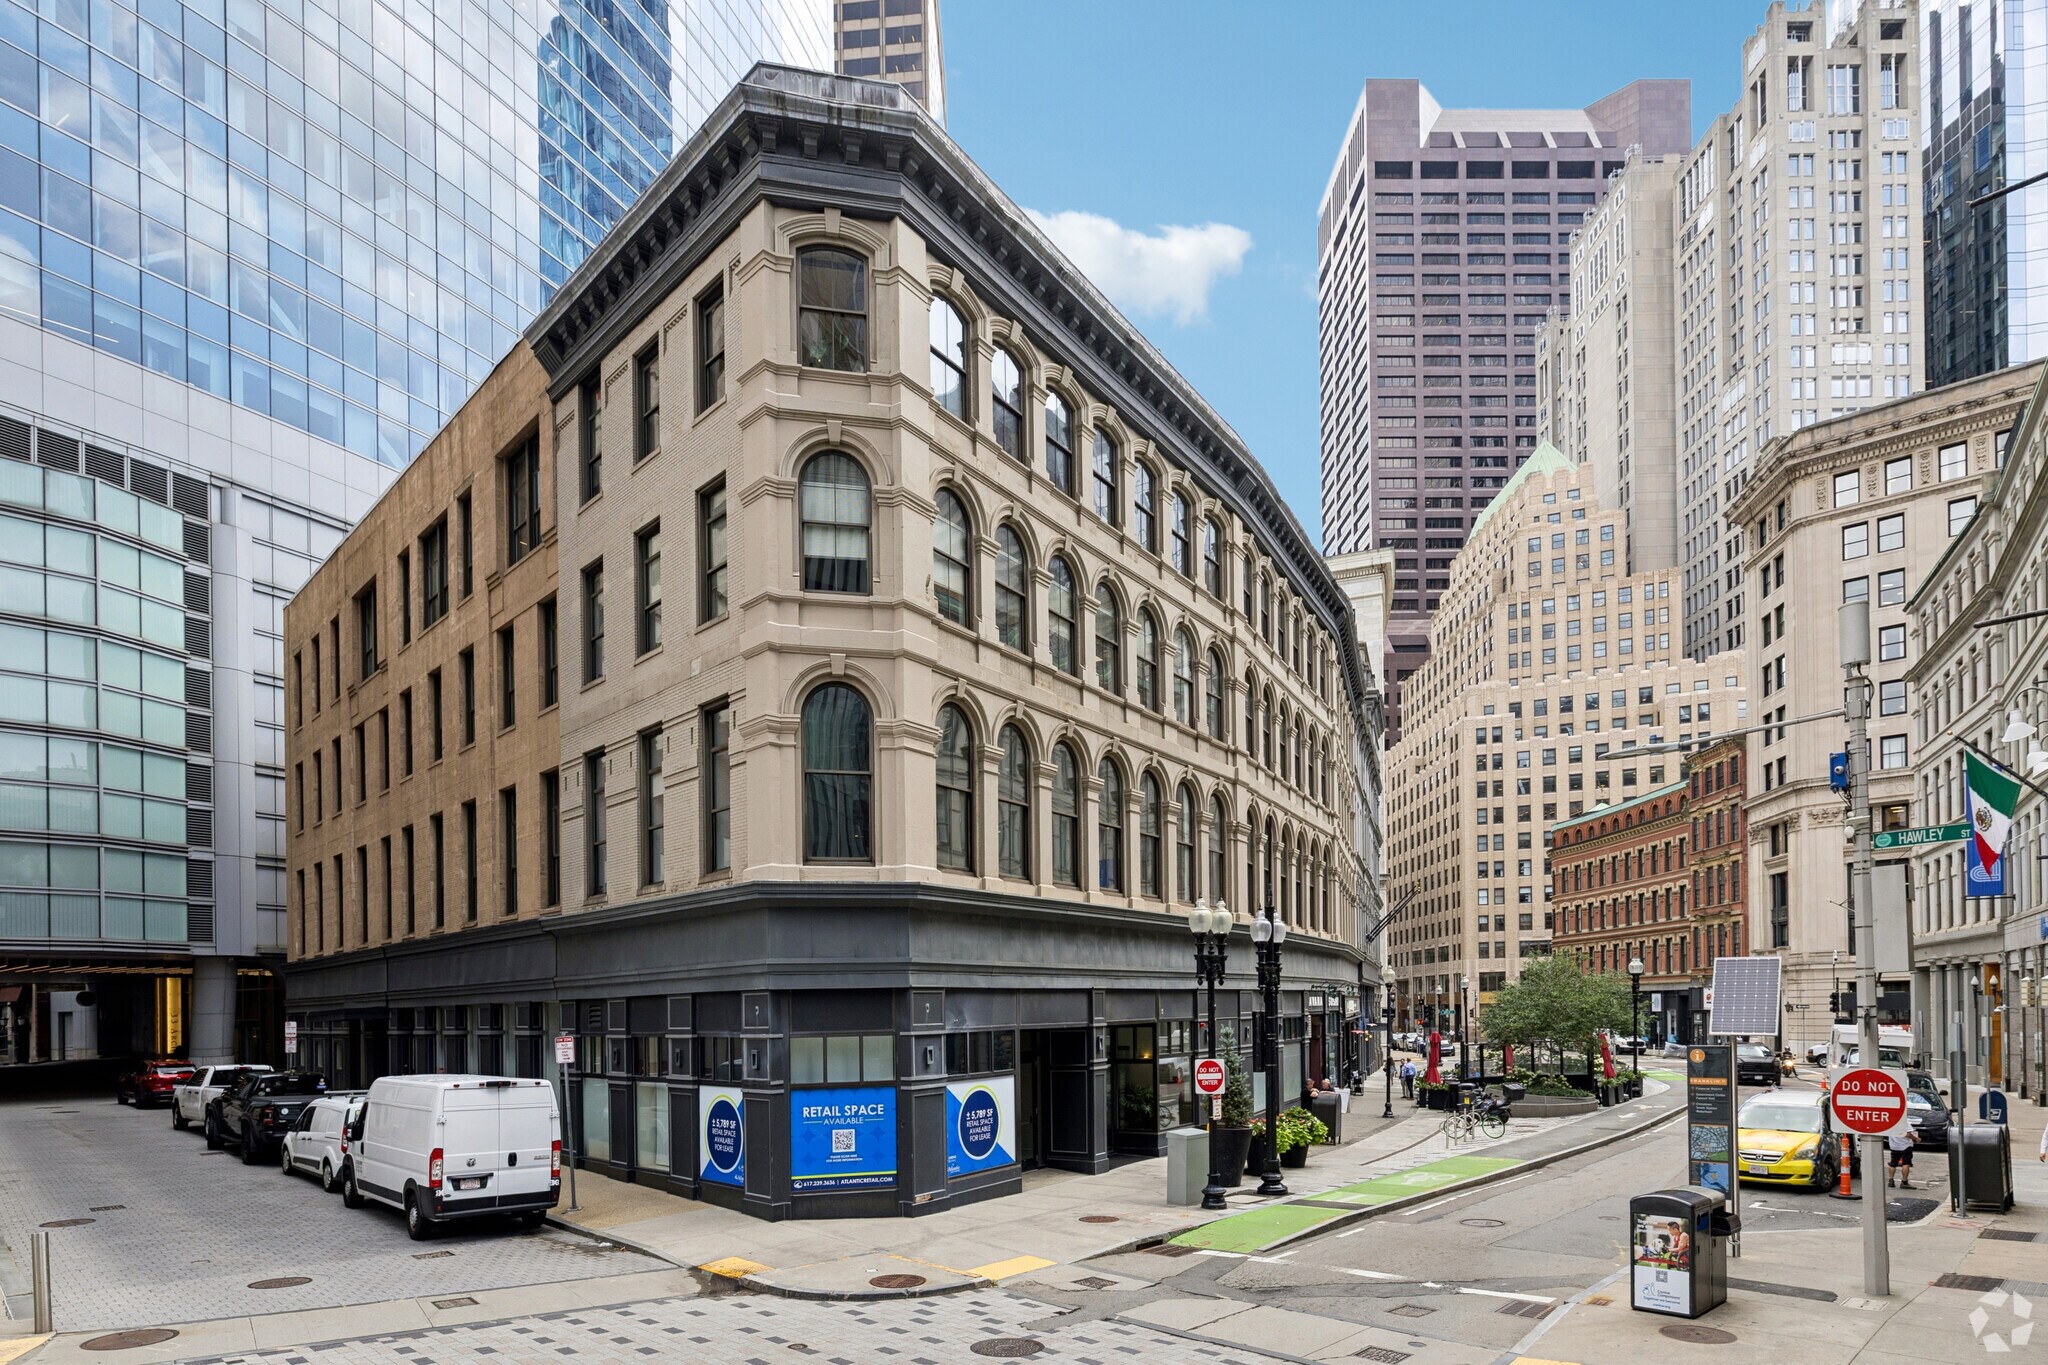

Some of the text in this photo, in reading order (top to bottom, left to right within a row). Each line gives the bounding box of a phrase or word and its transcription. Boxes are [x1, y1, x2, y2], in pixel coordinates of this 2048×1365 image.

[1898, 828, 1944, 844] HAWLEY
[1960, 830, 1970, 838] ST
[170, 1013, 178, 1024] 33
[1842, 1081, 1895, 1093] DO NOT
[803, 1104, 884, 1118] RETAIL SPACE
[971, 1110, 986, 1120] 5,789
[987, 1109, 993, 1117] SF
[1847, 1110, 1889, 1122] ENTER
[717, 1119, 729, 1128] 5,789
[730, 1120, 736, 1129] SF
[824, 1117, 864, 1125] AVAILABLE
[966, 1118, 993, 1128] RETAIL SPACE
[724, 1129, 736, 1138] SPACE
[969, 1125, 991, 1134] AVAILABLE
[714, 1137, 734, 1145] AVAILABLE
[723, 1145, 734, 1153] LEASE
